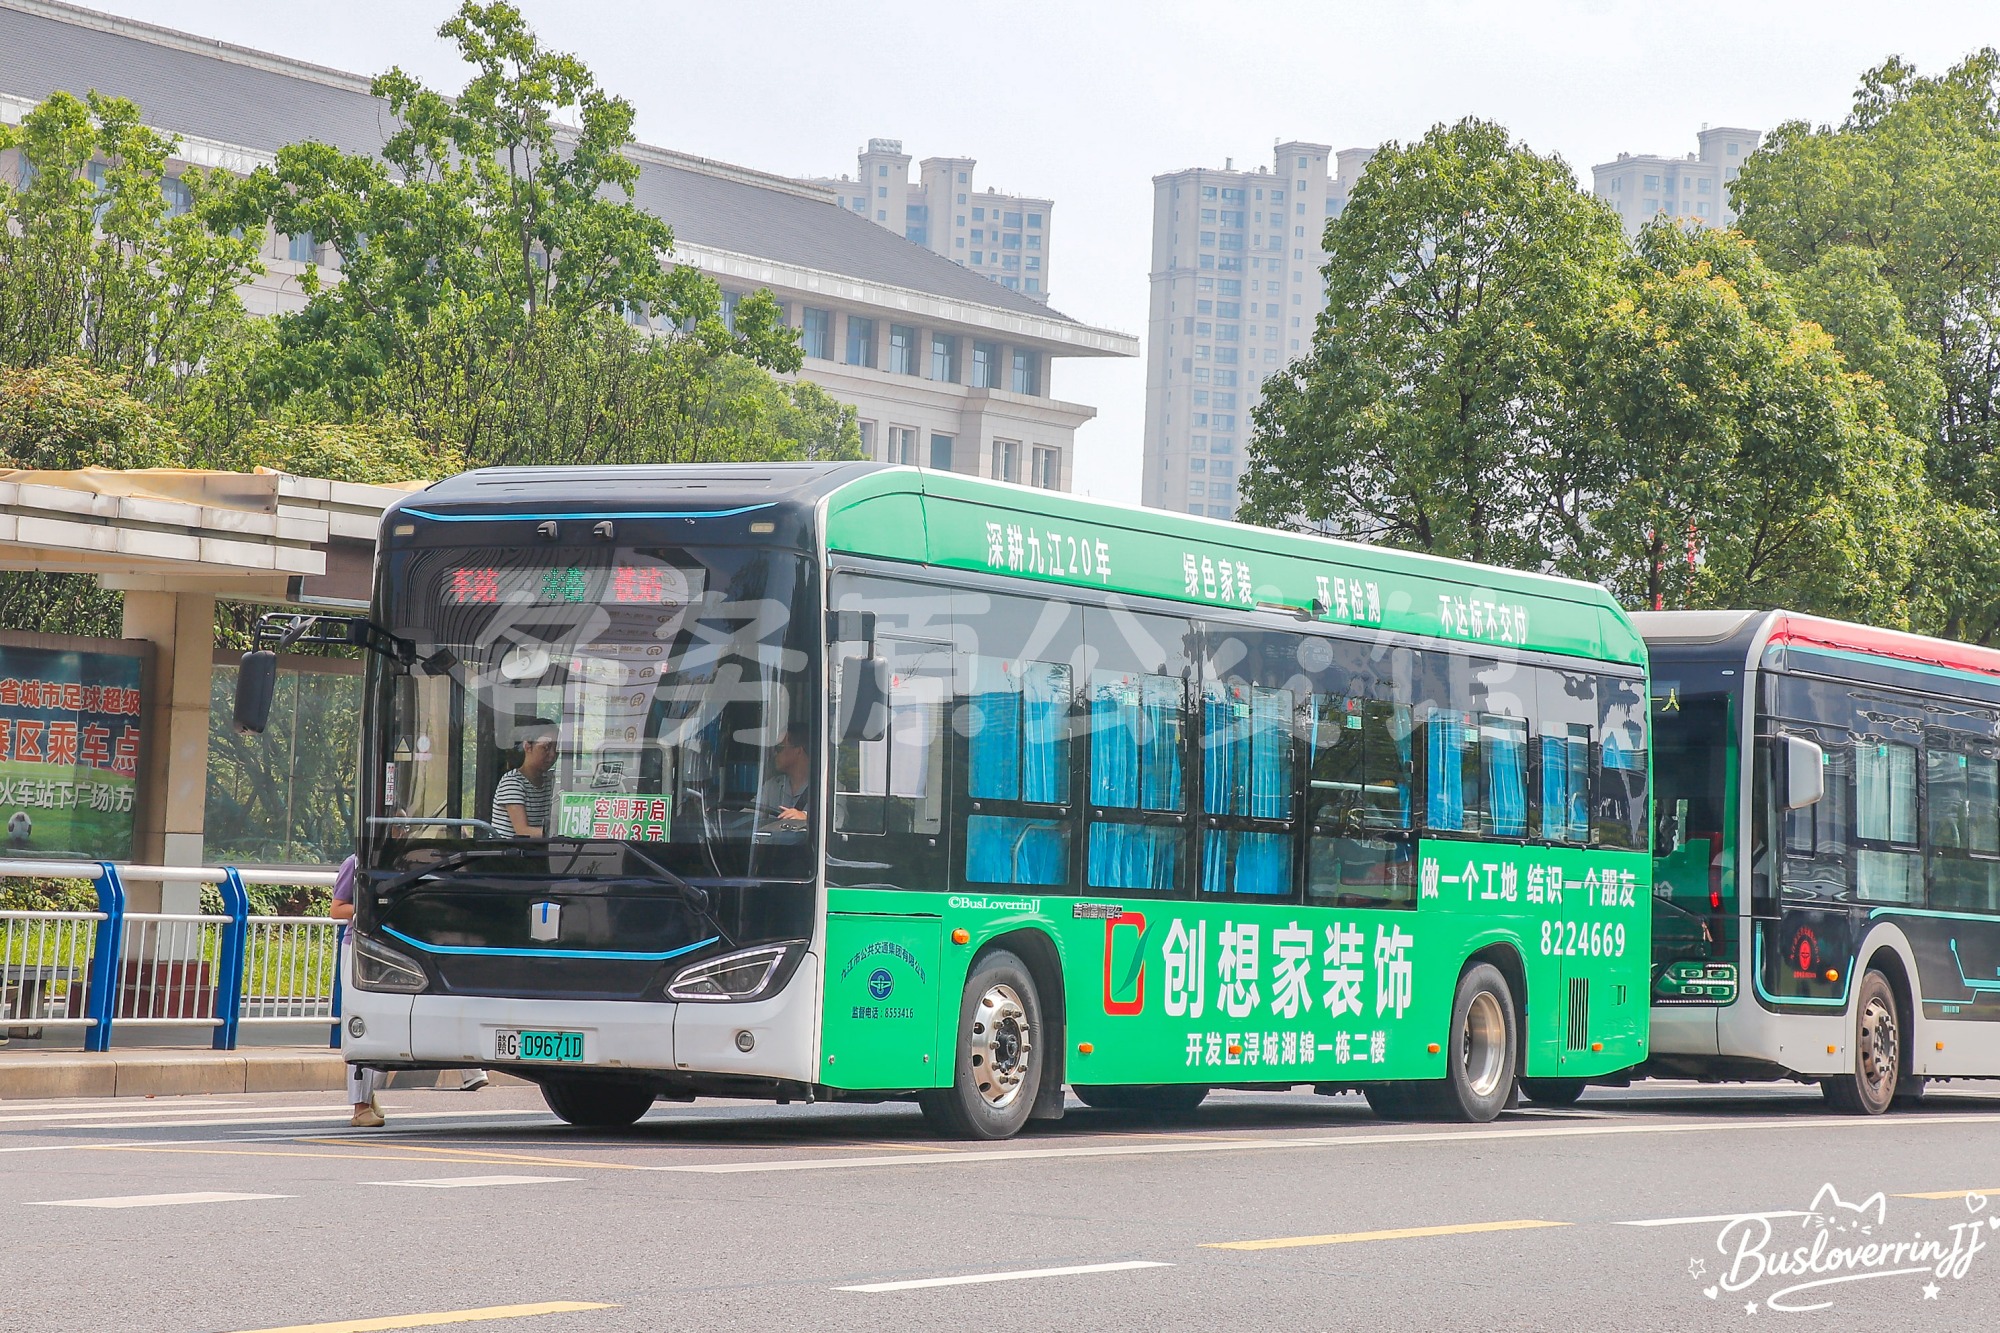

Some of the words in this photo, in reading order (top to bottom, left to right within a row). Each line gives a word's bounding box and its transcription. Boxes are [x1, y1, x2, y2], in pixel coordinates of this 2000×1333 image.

[985, 520, 1112, 585] 深耕九江20年
[1182, 551, 1253, 605] 绿色家装
[1315, 575, 1381, 623] 环保检测
[1438, 594, 1527, 645] 不达标不交付
[0, 678, 140, 716] 省城市足球超级
[563, 806, 592, 836] 75路
[594, 799, 666, 821] 空调开启
[1421, 857, 1518, 902] 做一个工地
[1526, 863, 1636, 907] 结识一个朋友
[1540, 920, 1626, 957] 8224669
[1162, 918, 1414, 1019] 创想家装饰
